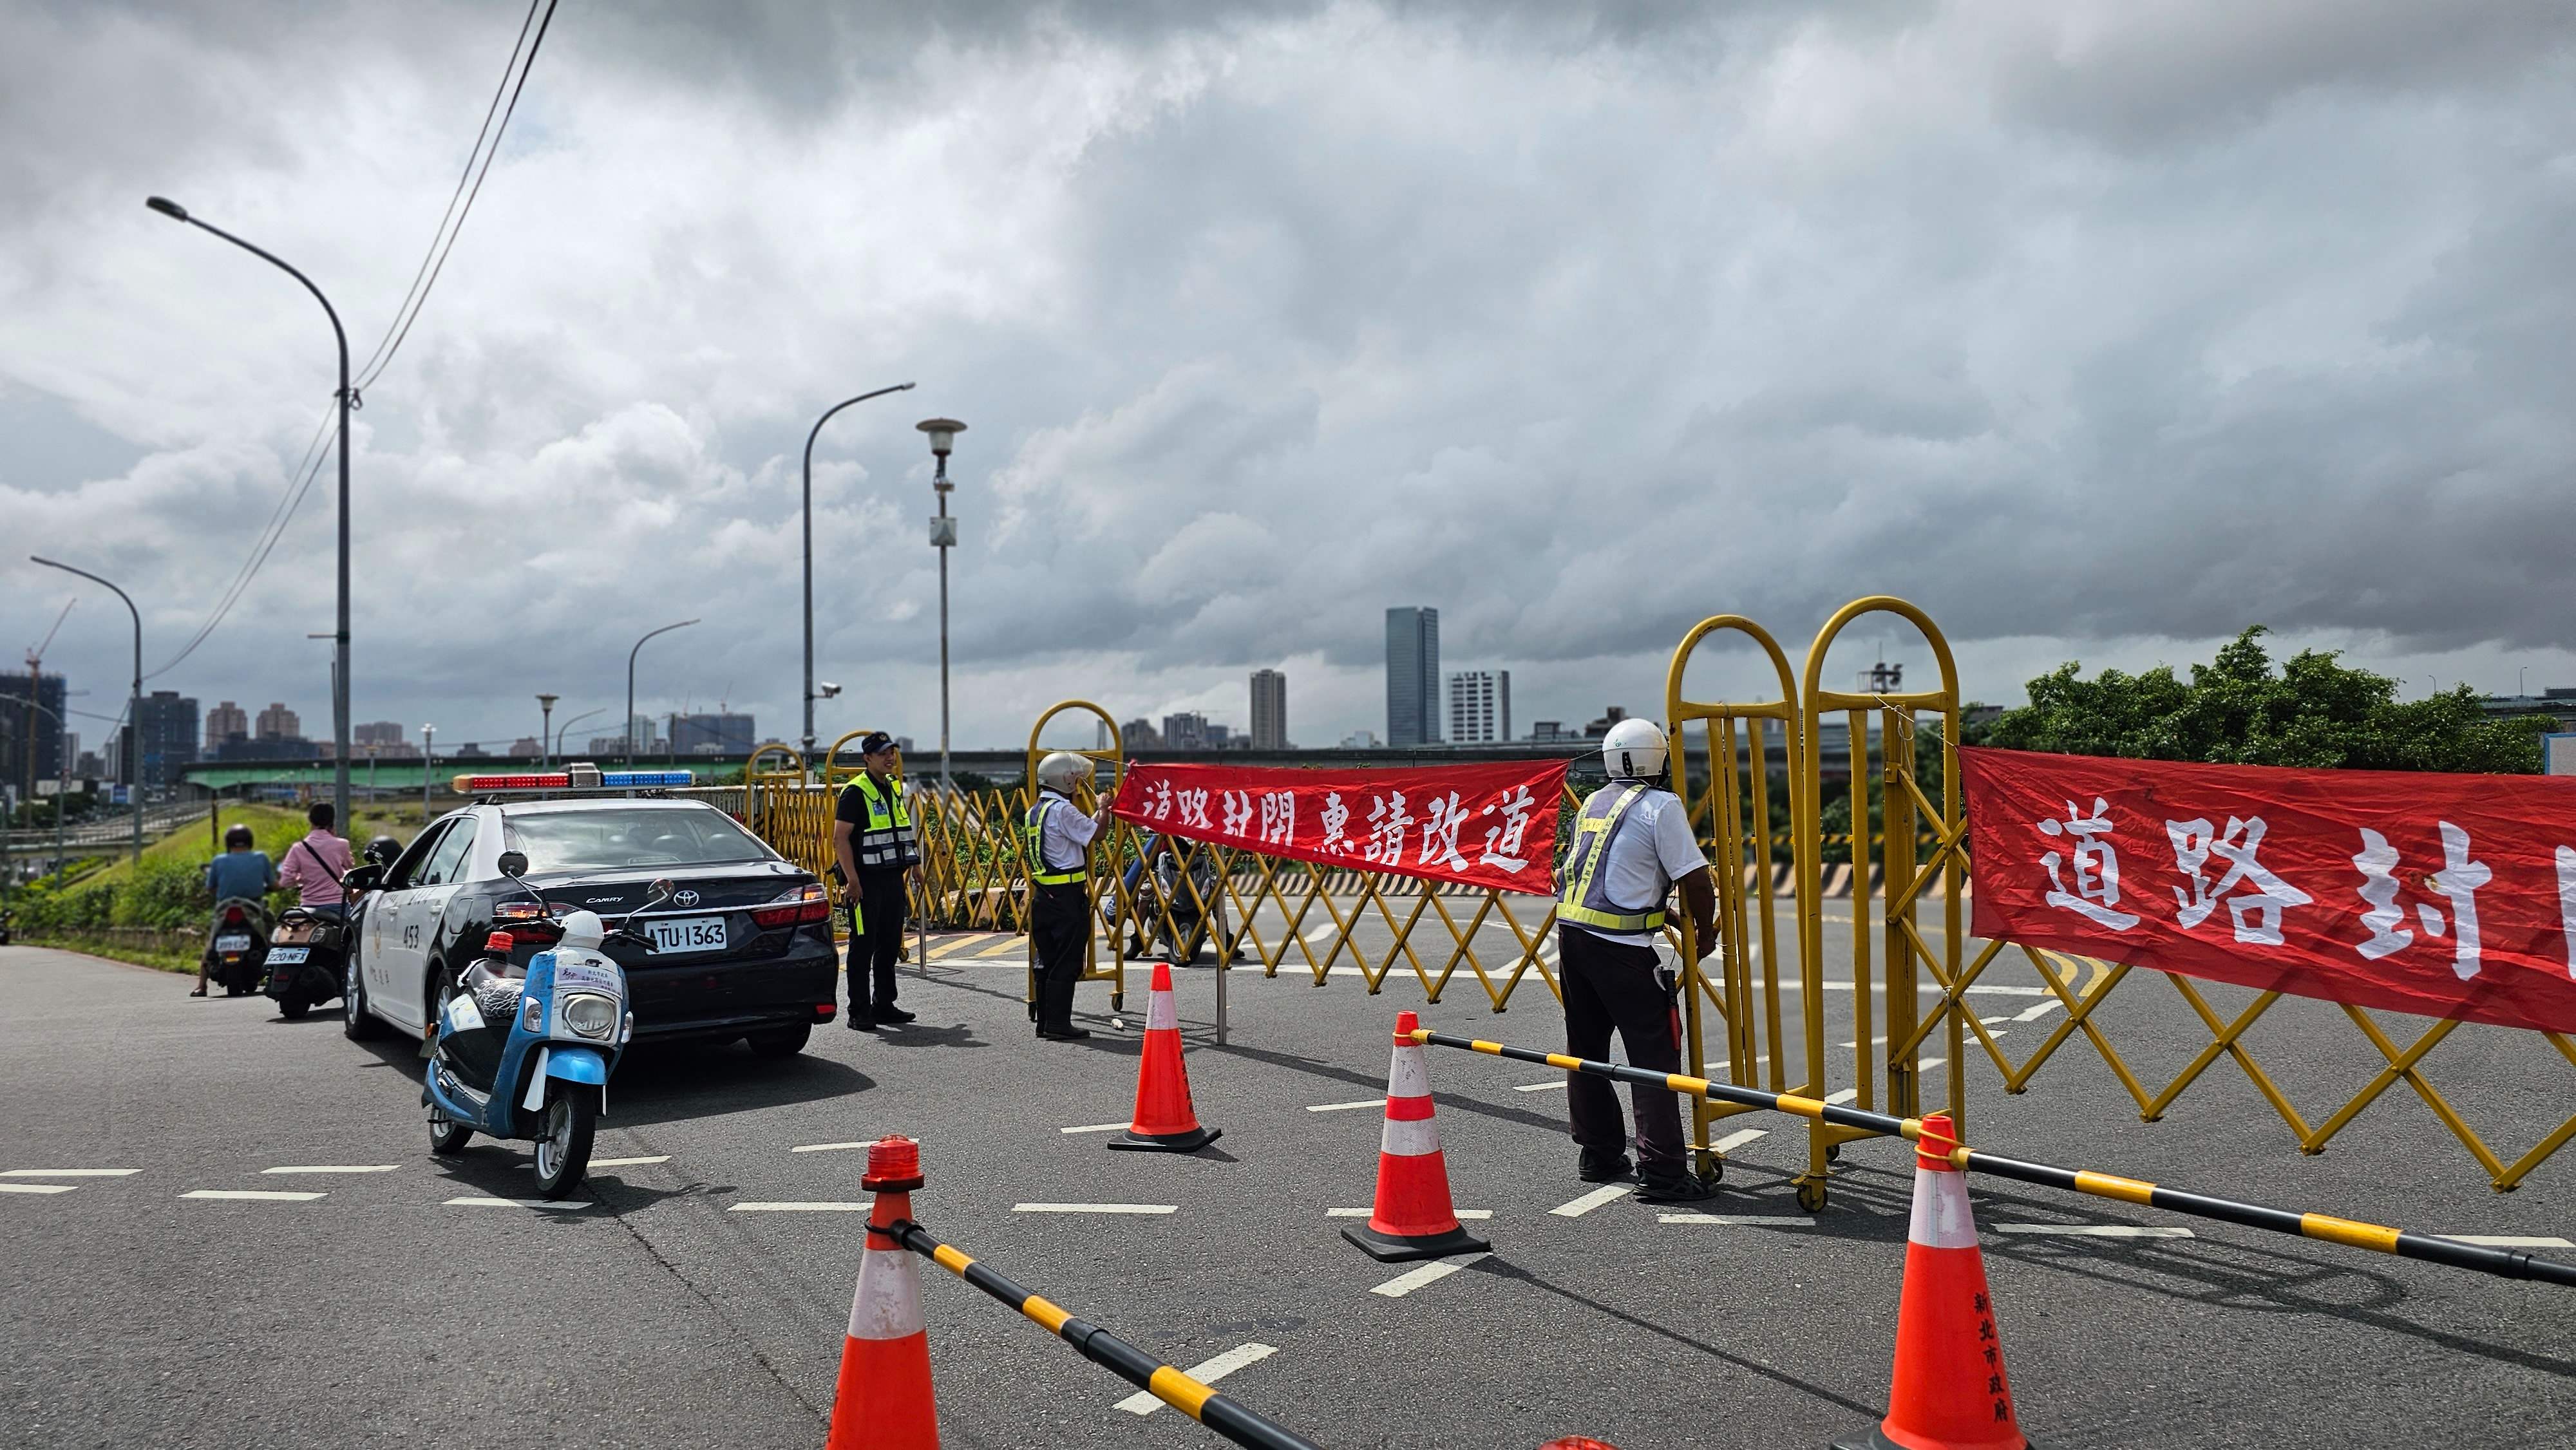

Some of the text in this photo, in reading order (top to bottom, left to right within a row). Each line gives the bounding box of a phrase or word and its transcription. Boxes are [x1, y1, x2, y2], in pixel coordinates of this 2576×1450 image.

[402, 925, 419, 949] 453
[2036, 796, 2576, 982] 道路封
[1973, 1290, 2009, 1423] 新北市政府
